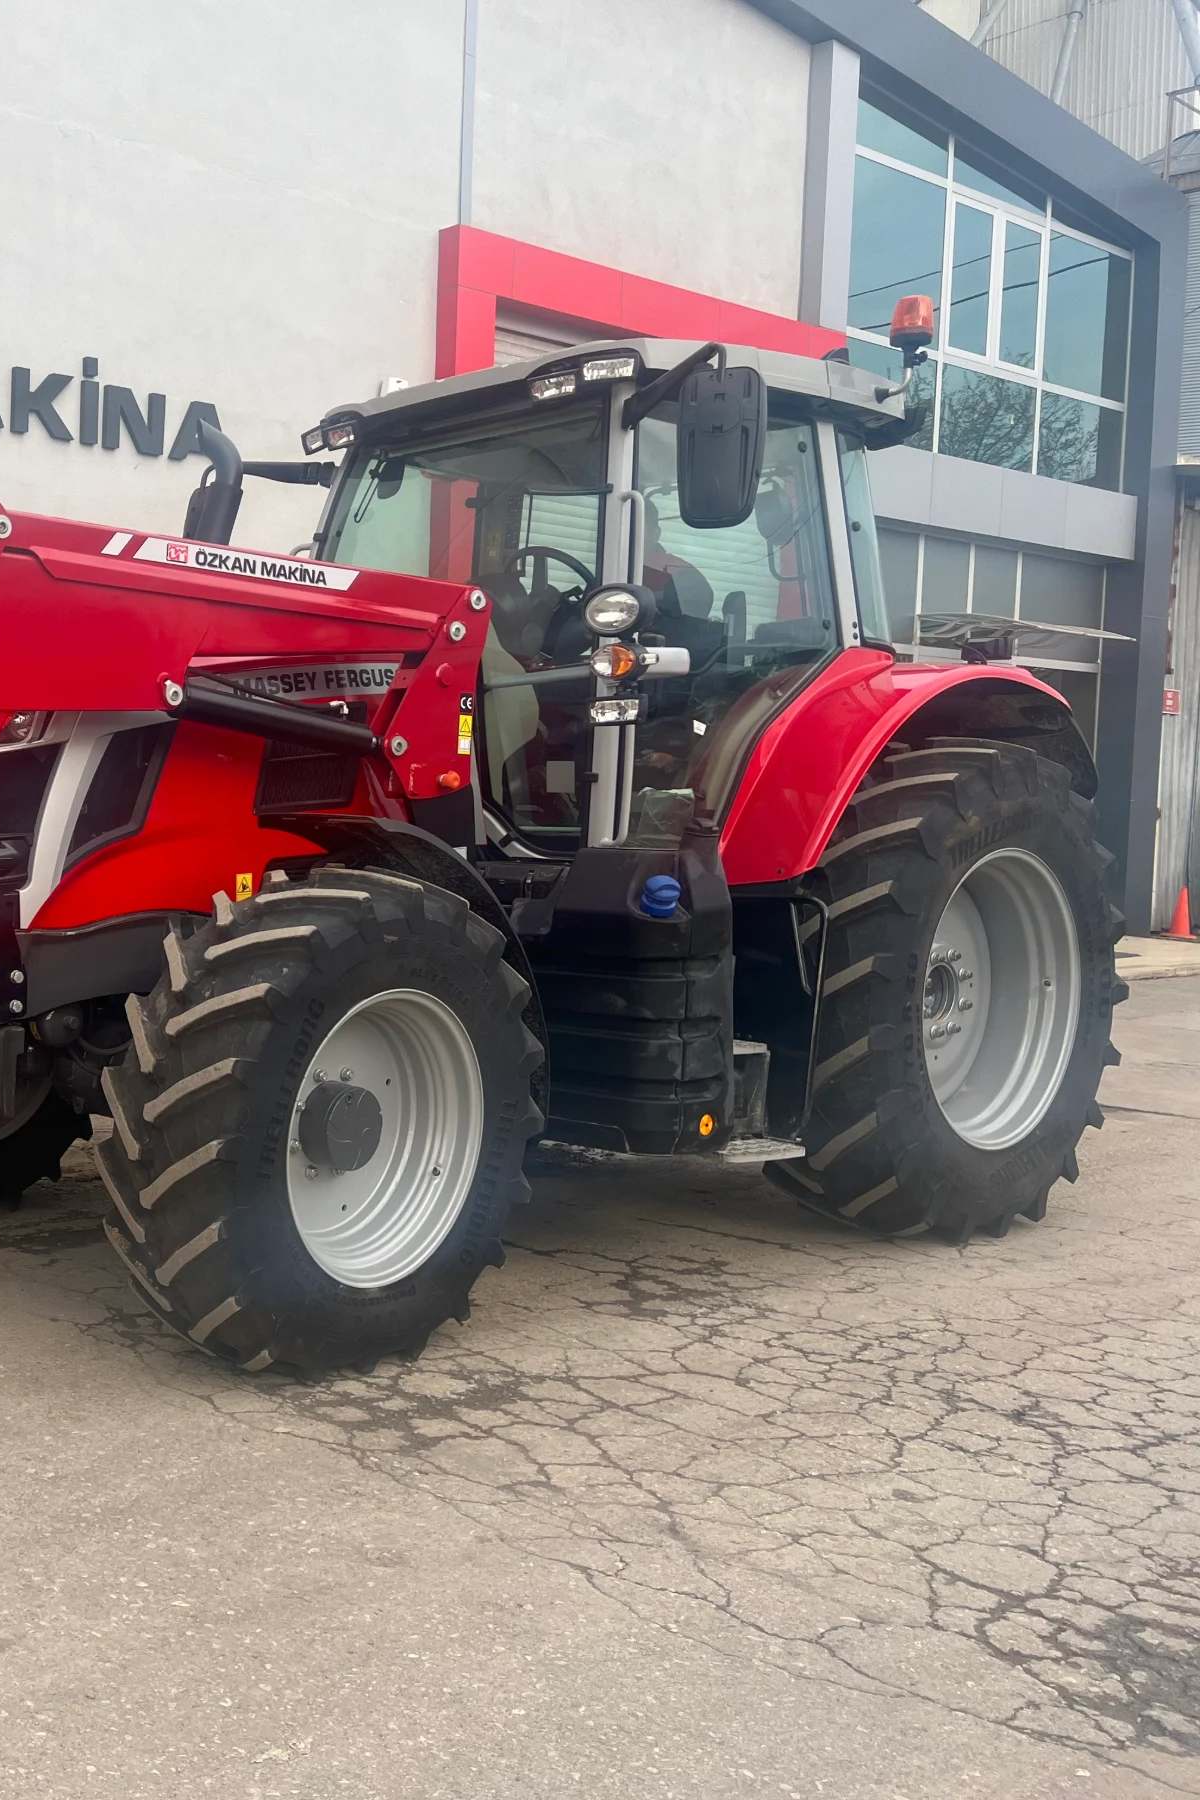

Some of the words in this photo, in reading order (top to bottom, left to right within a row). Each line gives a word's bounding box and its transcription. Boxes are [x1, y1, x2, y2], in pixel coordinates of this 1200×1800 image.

[195, 548, 256, 575] ÖZKAN
[260, 561, 327, 586] MAKİNA
[325, 668, 399, 690] FERGUS
[460, 696, 473, 710] CE
